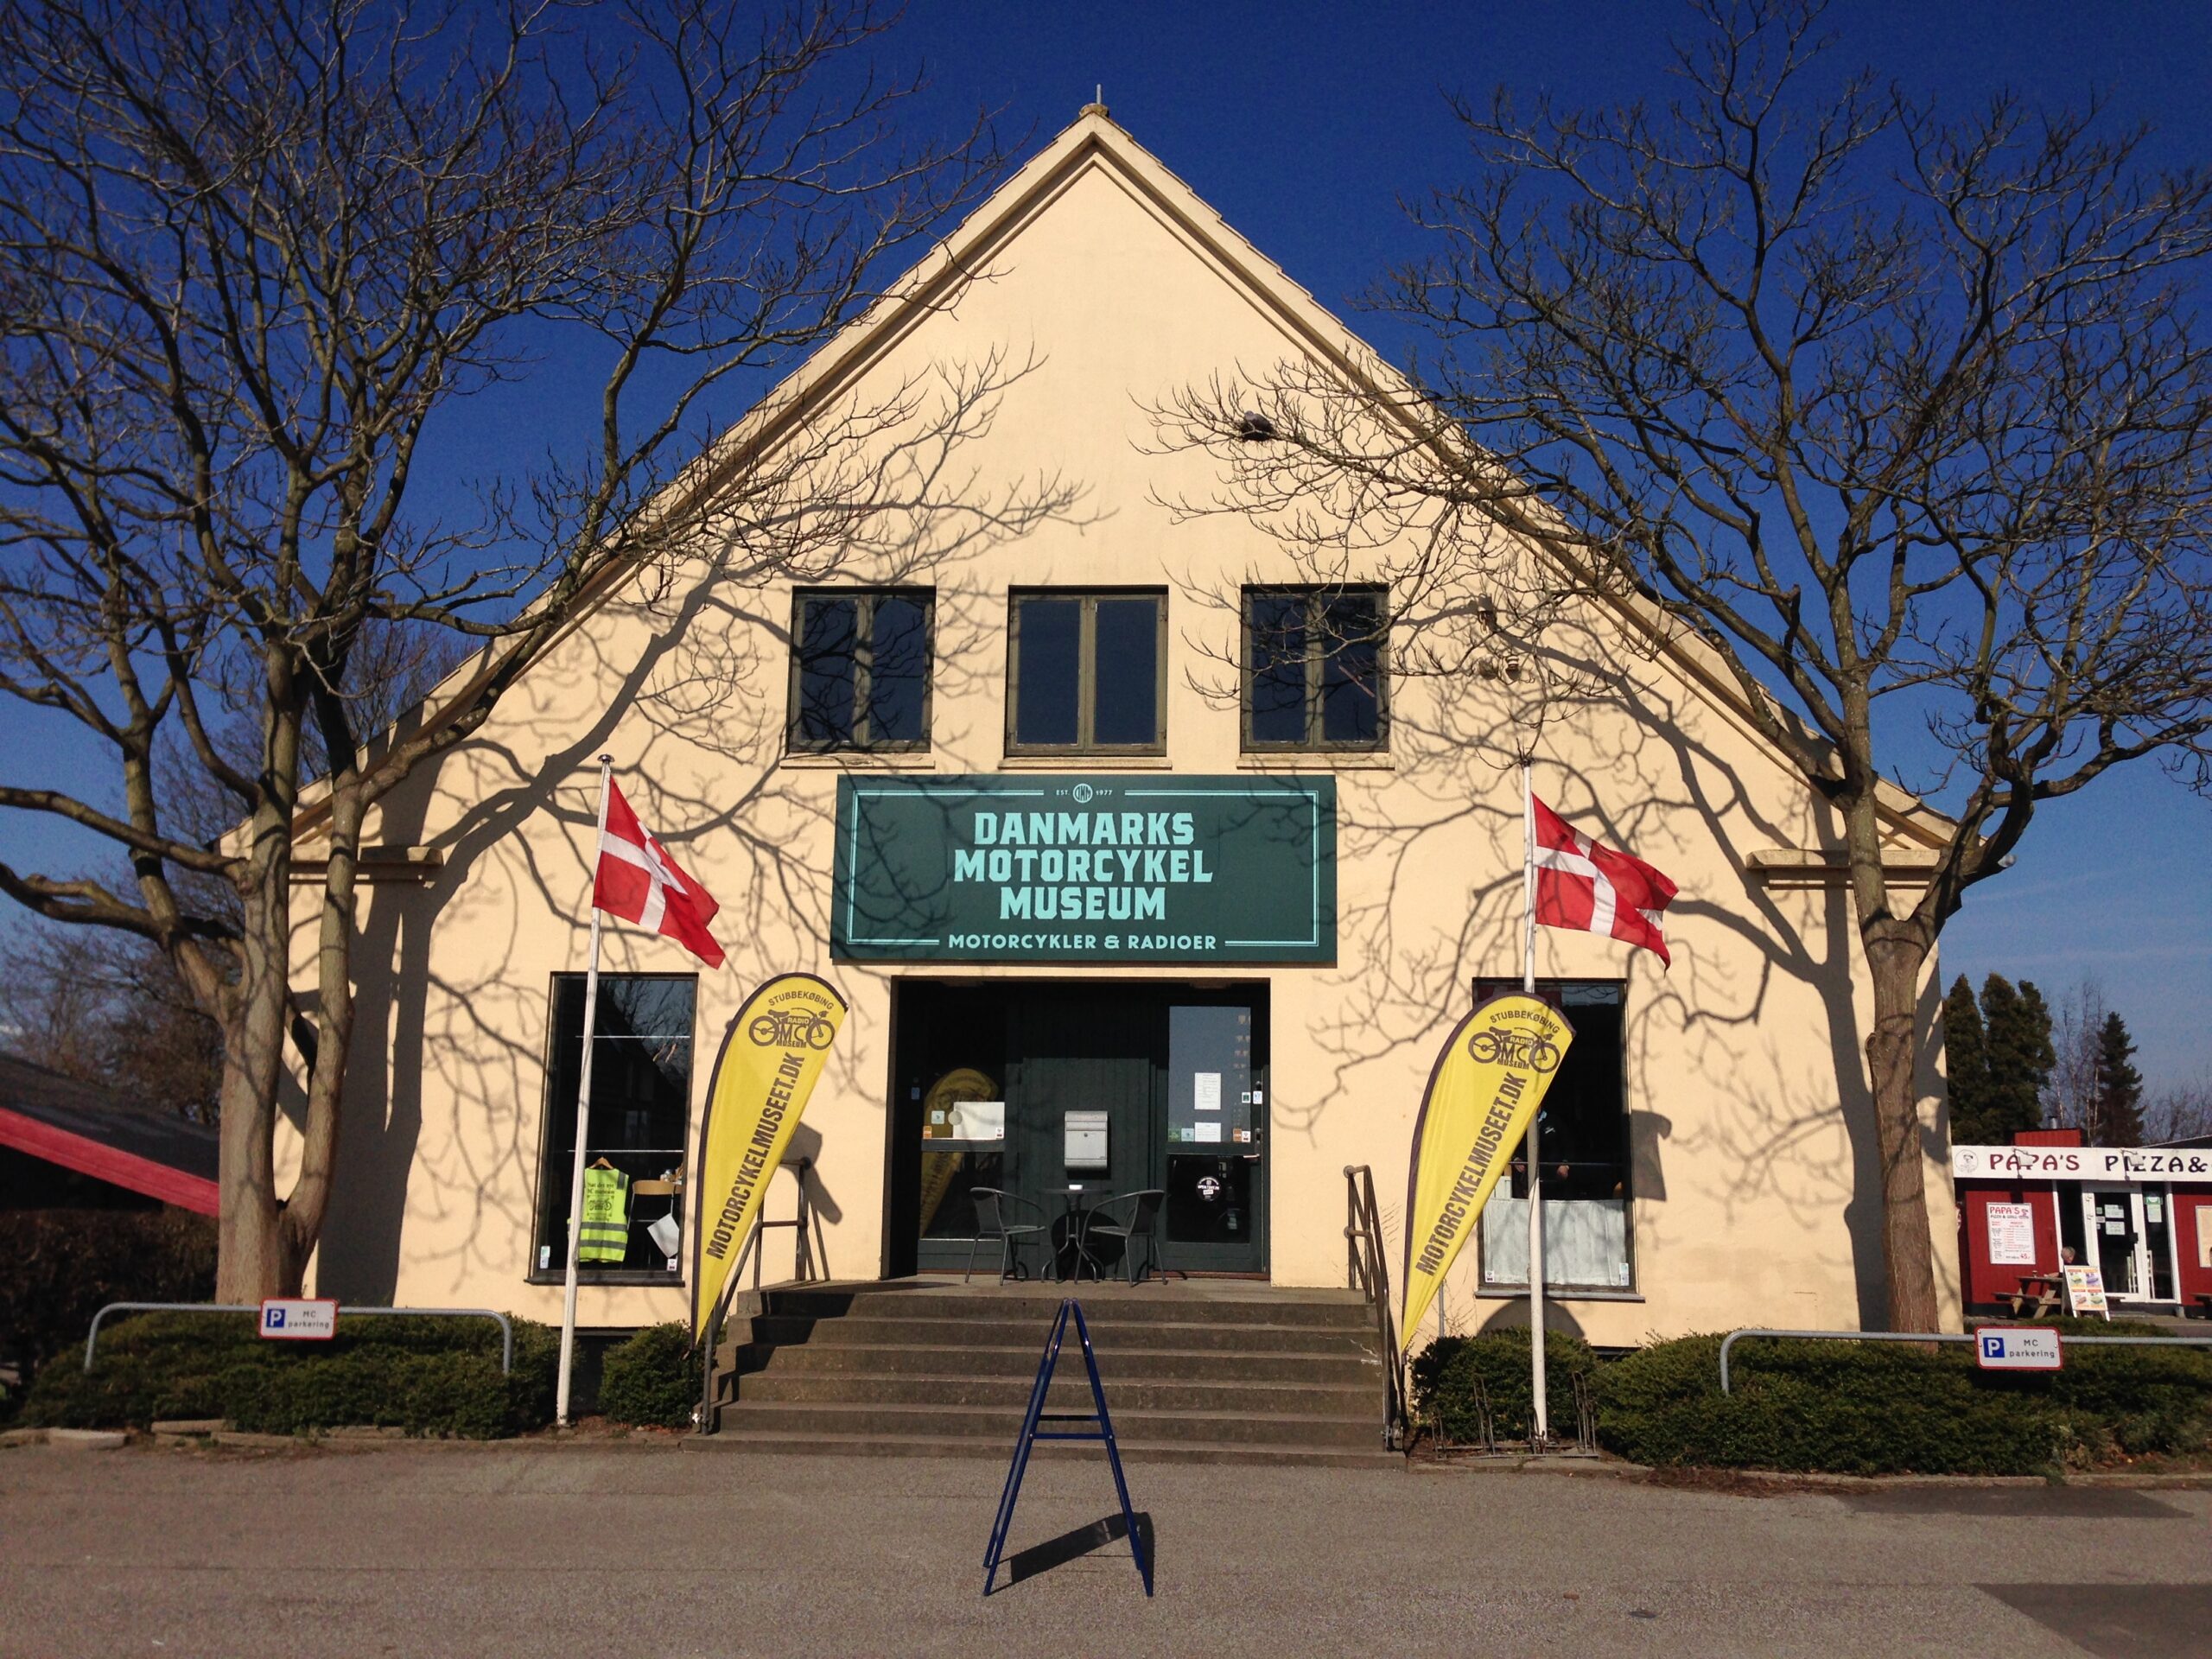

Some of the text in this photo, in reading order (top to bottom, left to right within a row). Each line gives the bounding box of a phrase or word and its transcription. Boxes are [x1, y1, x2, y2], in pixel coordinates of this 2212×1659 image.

[974, 812, 1194, 845] DANMARKS
[953, 849, 1213, 883] MOTORCYKEL
[999, 887, 1166, 920] MUSEUM
[948, 934, 1217, 950] MOTORCYKLER & RADIOER
[768, 991, 834, 1009] STUBBEKØBING
[1490, 1010, 1560, 1033] STUBBEKØBING
[779, 1024, 807, 1042] MC
[1509, 1037, 1533, 1046] RADIO
[776, 1039, 807, 1048] MUSEUM
[1501, 1042, 1530, 1063] MC
[1497, 1058, 1529, 1070] MUSEUM
[705, 1052, 805, 1261] MOTORCYKELMUSEET.DK
[1415, 1071, 1528, 1276] MOTORCYKELMUSEET.DK
[270, 1310, 283, 1327] P
[1987, 1338, 2001, 1357] P
[2009, 1350, 2055, 1358] parkering
